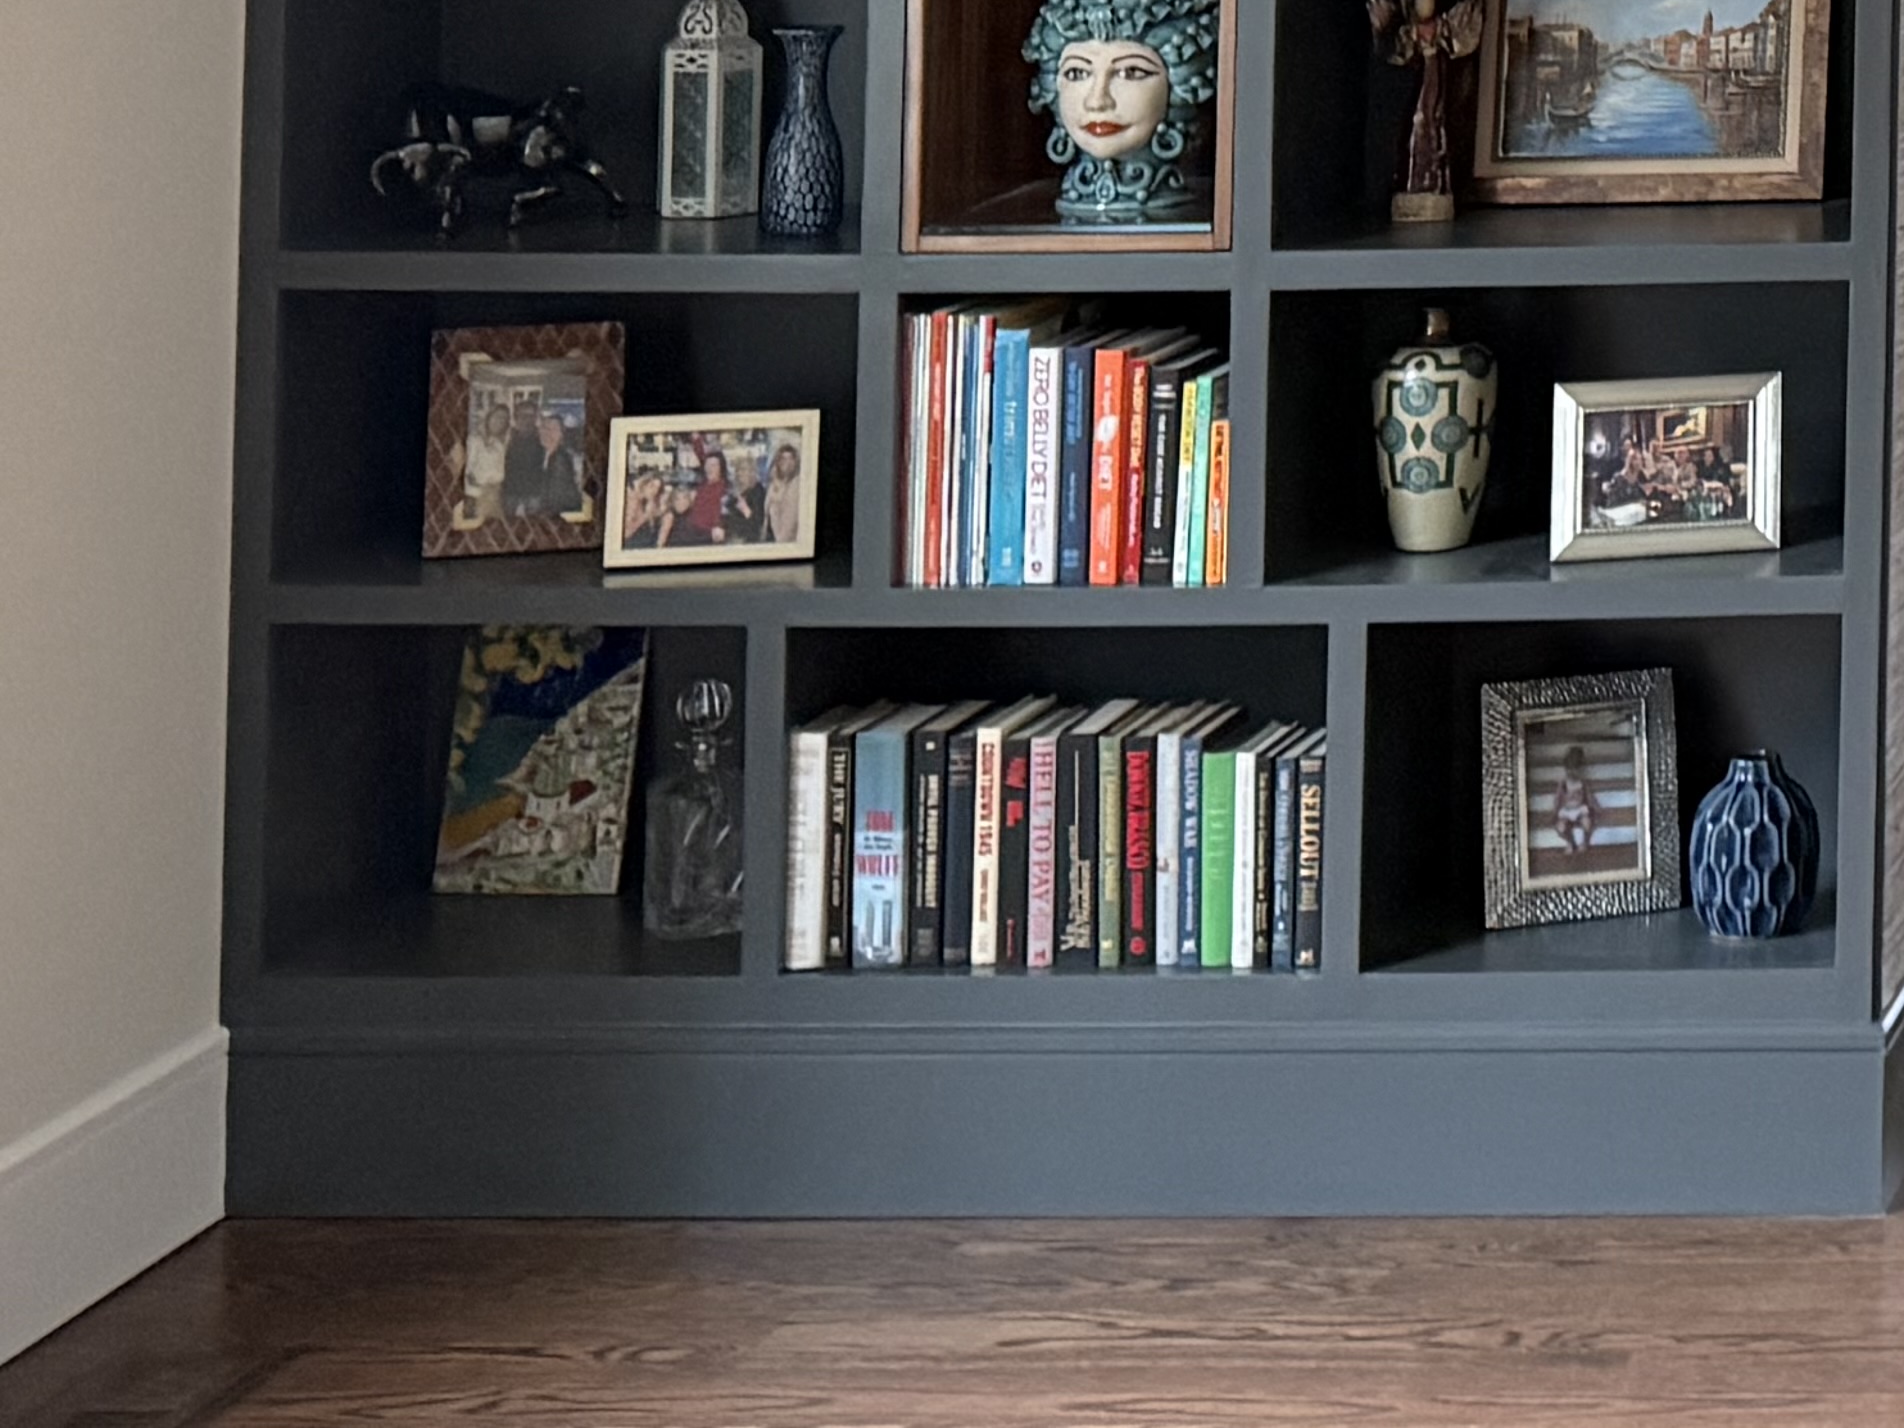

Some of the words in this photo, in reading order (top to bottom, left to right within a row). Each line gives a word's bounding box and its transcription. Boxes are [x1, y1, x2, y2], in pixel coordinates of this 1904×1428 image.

[1032, 356, 1051, 406] ZERO
[1031, 408, 1049, 459] BELLY
[832, 753, 847, 785] THE
[1033, 751, 1053, 815] HELL
[1184, 749, 1199, 811] SHADOW
[830, 787, 846, 826] JURY
[978, 825, 993, 857] 1945
[1033, 823, 1053, 852] TO
[1299, 784, 1322, 880] SELLOUT
[1032, 860, 1052, 905] PAY
